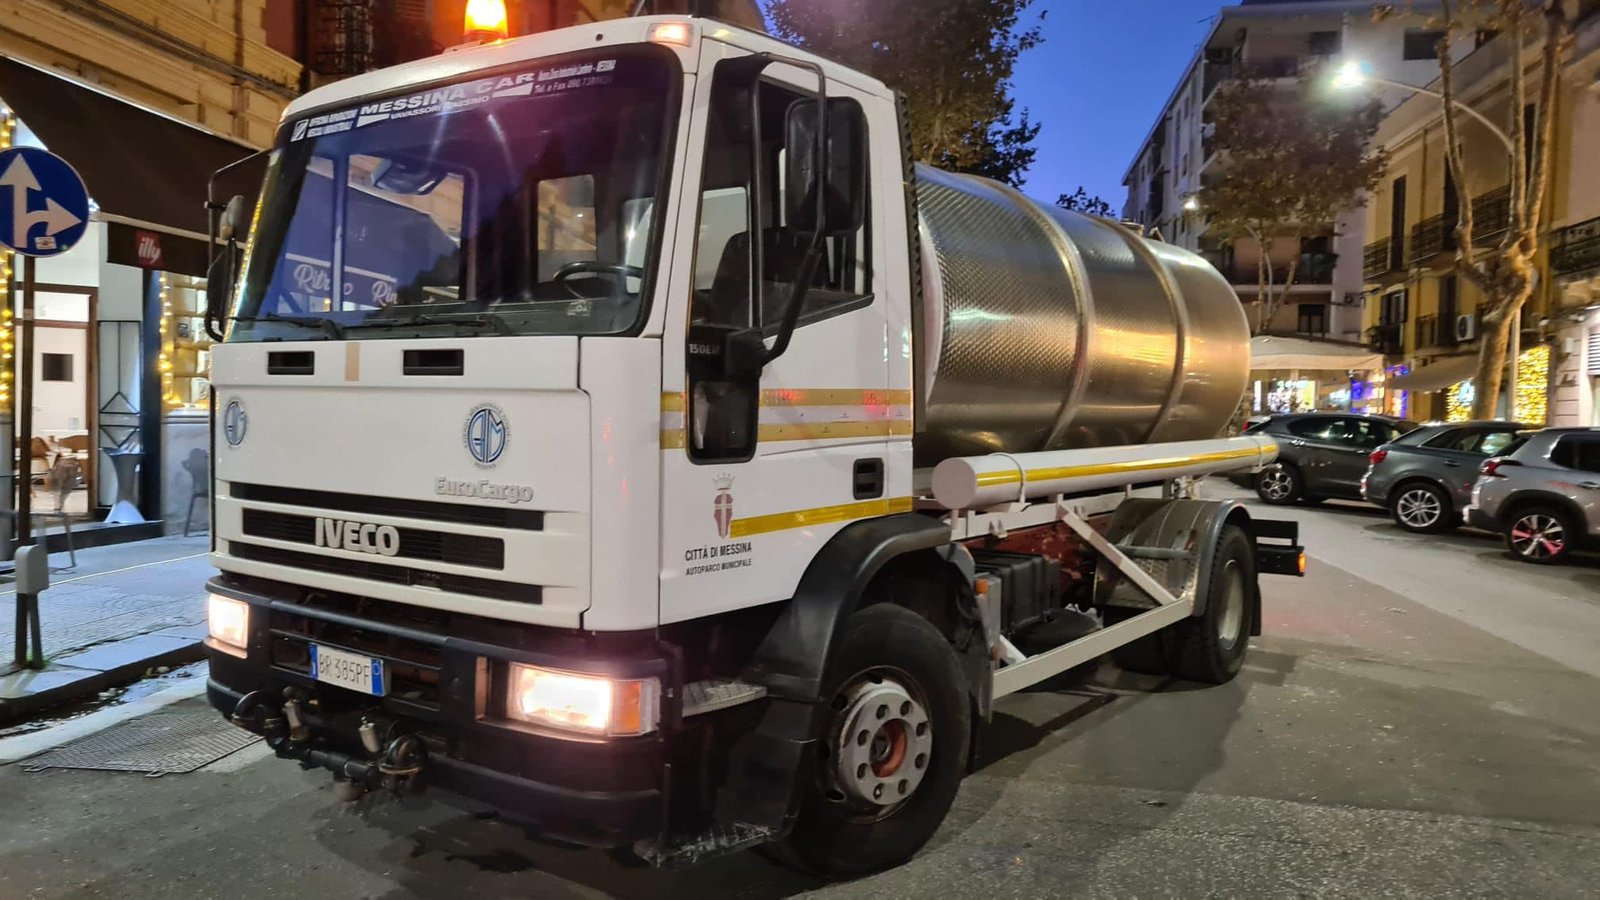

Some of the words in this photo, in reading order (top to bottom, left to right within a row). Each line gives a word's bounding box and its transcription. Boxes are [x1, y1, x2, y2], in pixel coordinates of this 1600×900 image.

[360, 86, 465, 115] MESSINA
[476, 73, 535, 94] CAR
[138, 236, 162, 264] illy
[435, 477, 534, 504] EuroCargo
[315, 517, 400, 557] IVECO
[710, 546, 719, 558] DI
[720, 541, 752, 556] MESSINA
[686, 563, 721, 576] AUTOPARCO
